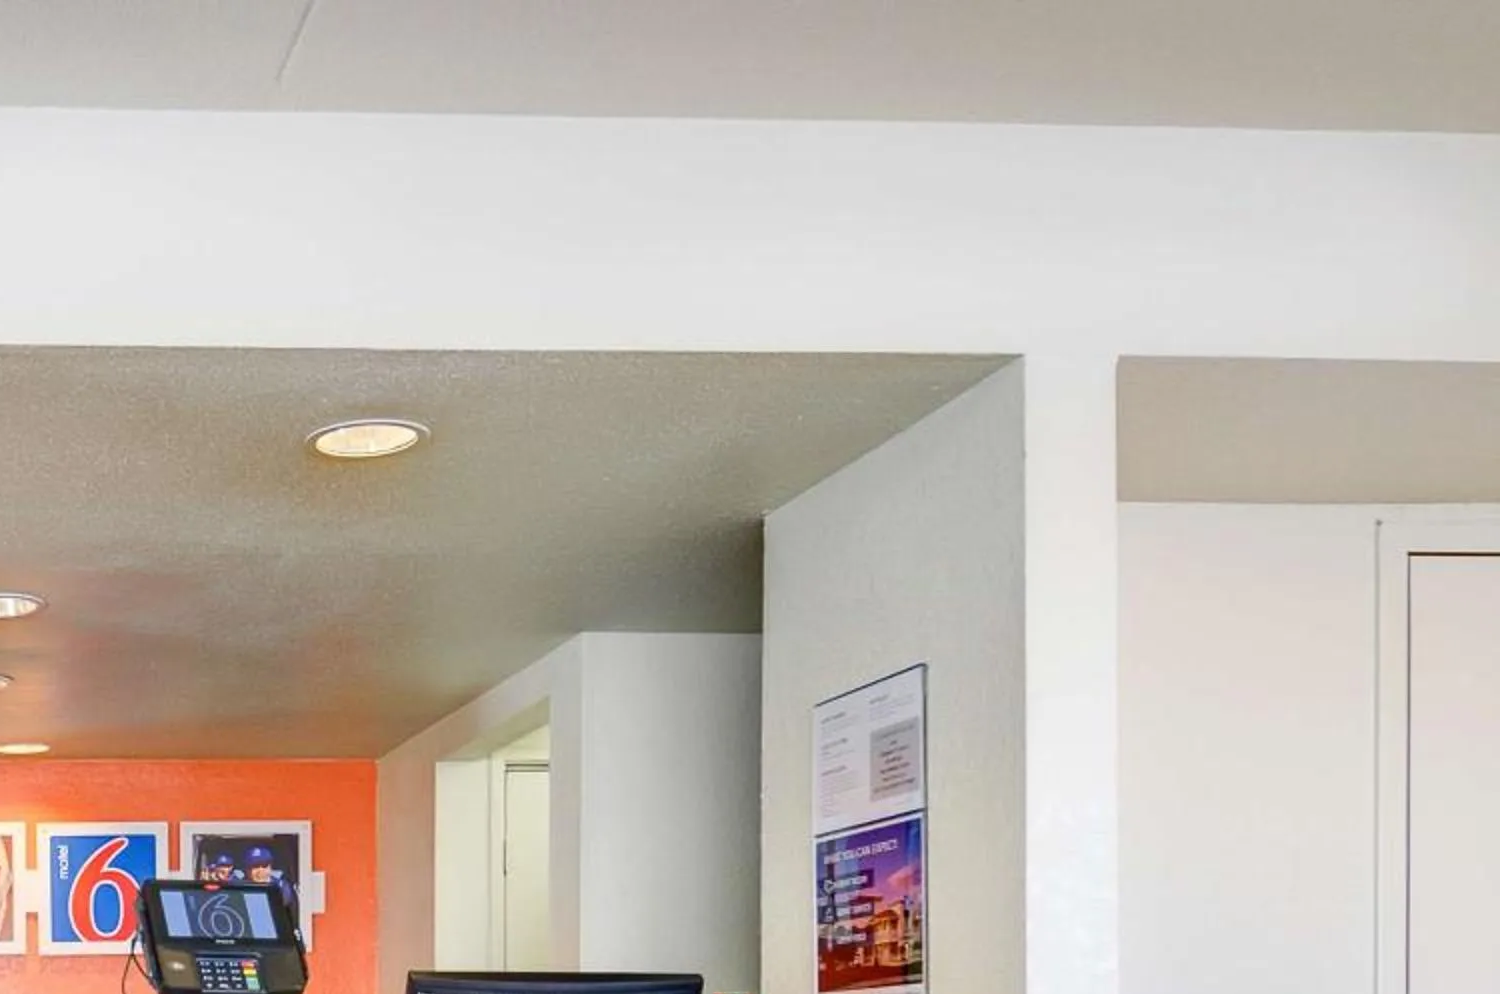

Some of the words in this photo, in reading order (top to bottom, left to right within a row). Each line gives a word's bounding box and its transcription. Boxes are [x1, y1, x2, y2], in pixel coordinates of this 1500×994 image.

[57, 845, 68, 880] motel
[69, 837, 141, 942] 6
[198, 893, 245, 938] 6
